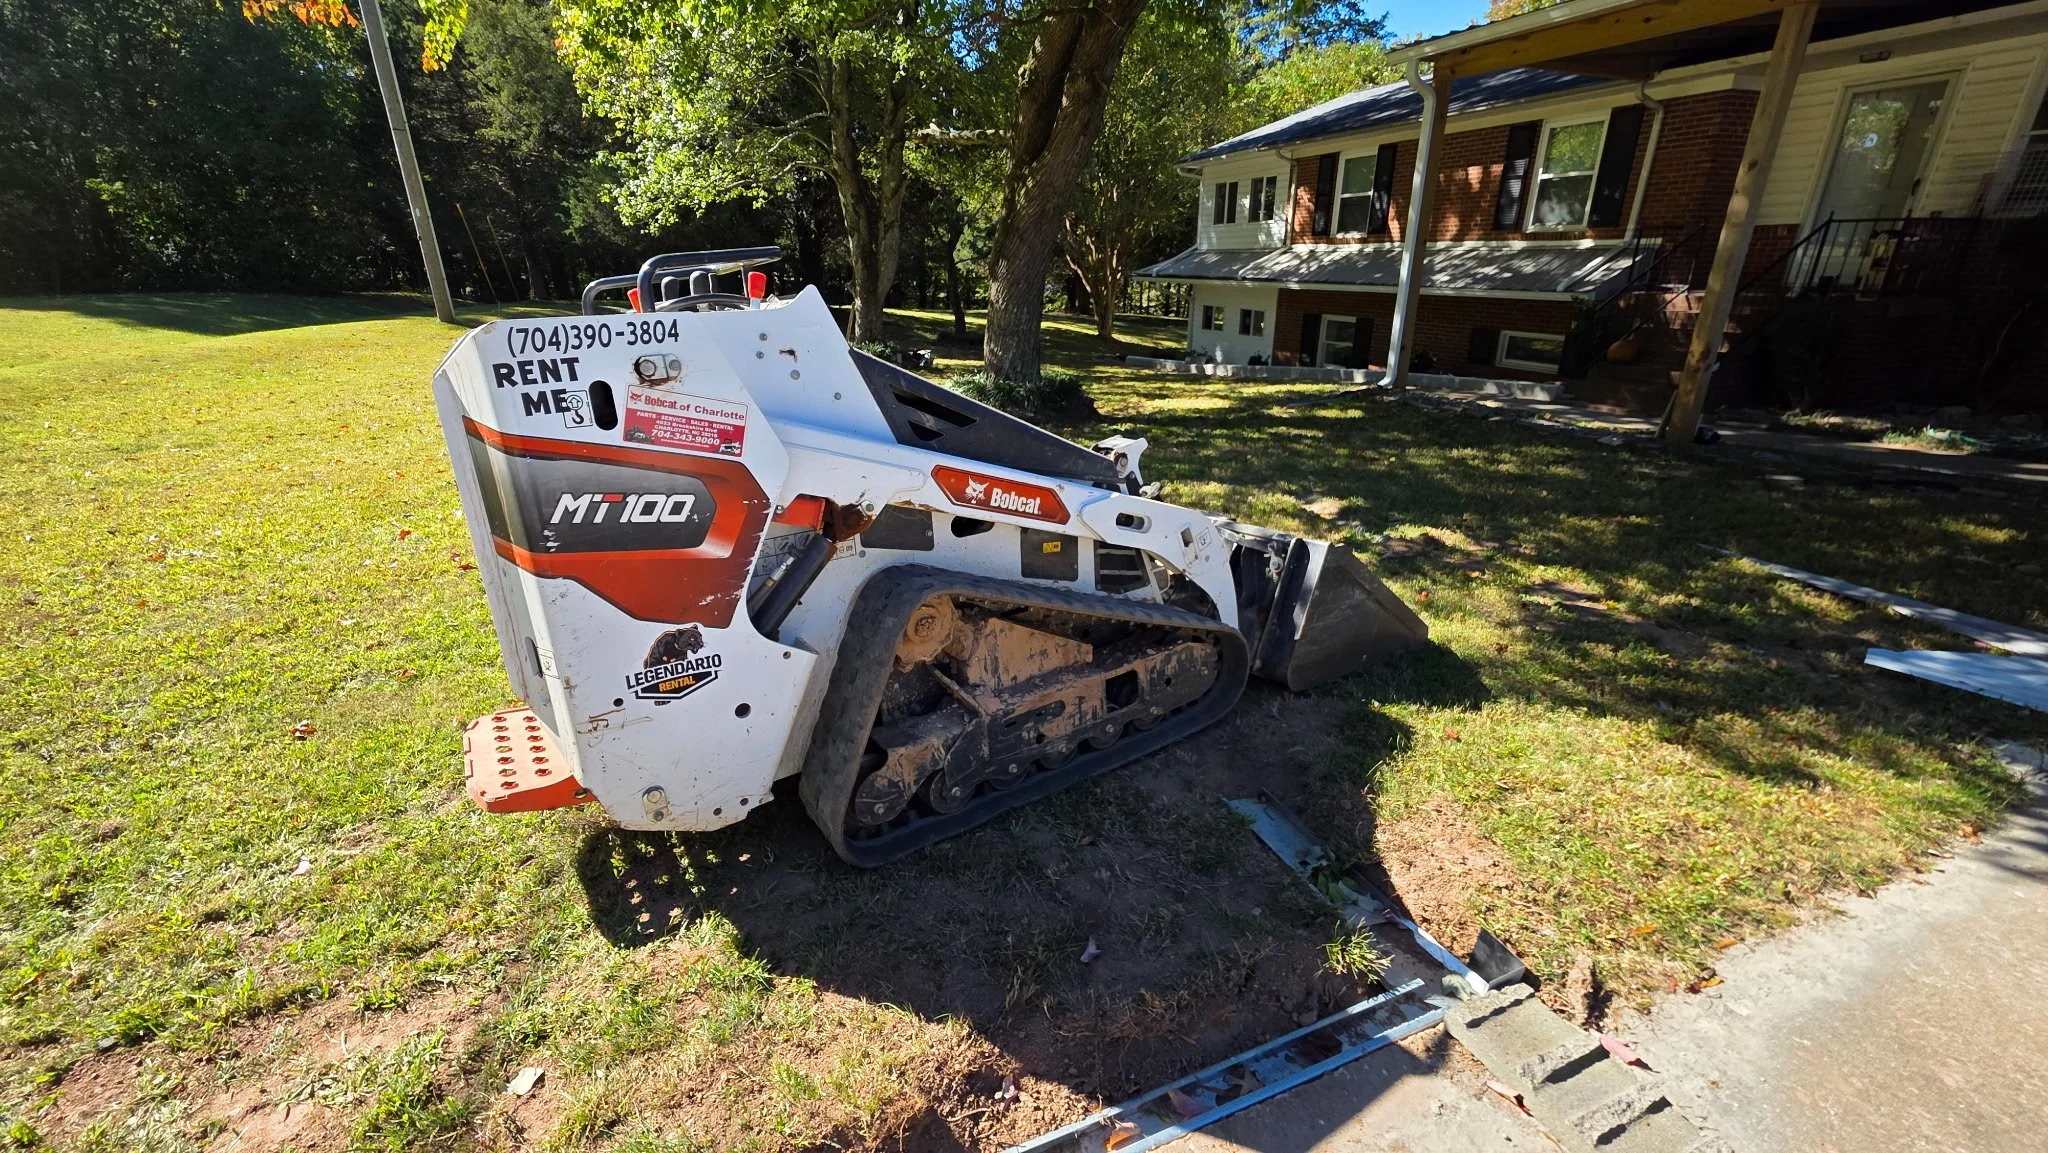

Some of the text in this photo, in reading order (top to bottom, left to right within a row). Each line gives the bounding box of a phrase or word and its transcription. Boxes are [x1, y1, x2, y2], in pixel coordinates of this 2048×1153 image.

[507, 319, 680, 358] (704)390-3804
[492, 356, 580, 389] RENT
[521, 388, 572, 417] ME
[644, 395, 745, 421] Bobcat of Charlotte
[636, 411, 734, 431] PARTS SERVICE SALES RENTAL
[704, 426, 718, 434] Blvd
[651, 429, 720, 446] 704-343-9000
[550, 493, 696, 524] MT100
[990, 487, 1041, 515] Bobcat
[625, 653, 723, 690] LEGENDARIO
[658, 675, 696, 693] RENTAL
